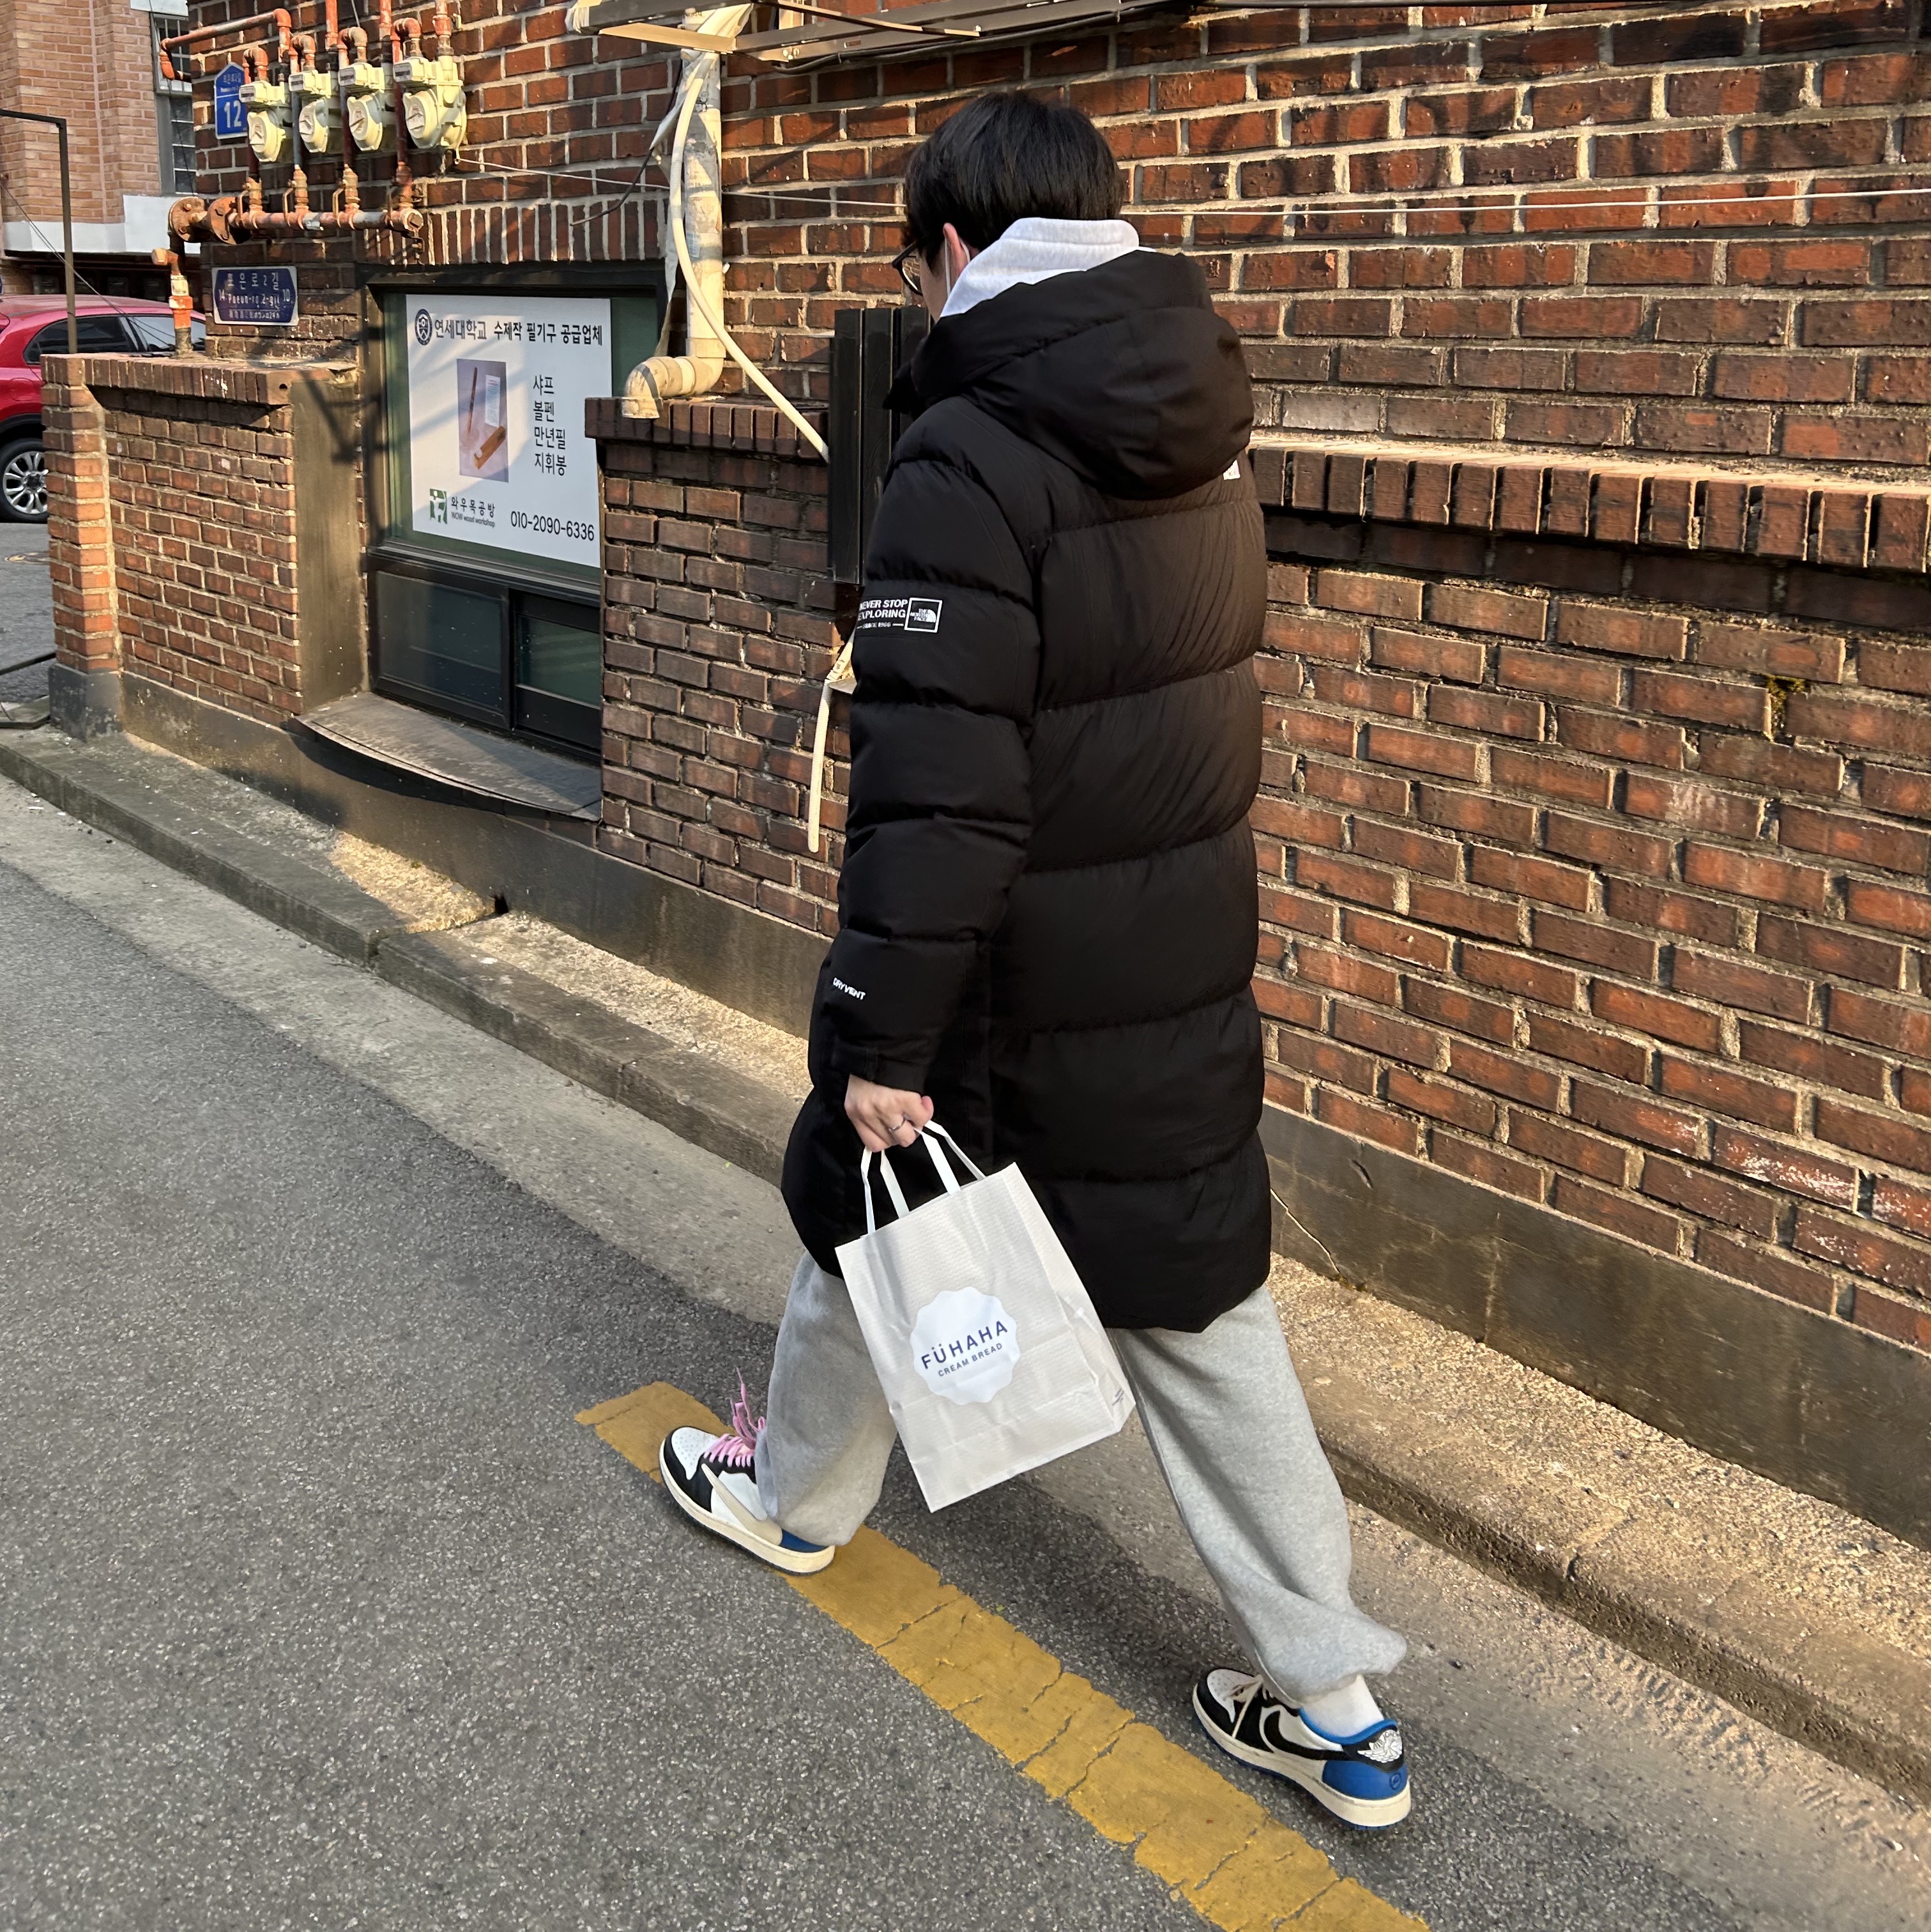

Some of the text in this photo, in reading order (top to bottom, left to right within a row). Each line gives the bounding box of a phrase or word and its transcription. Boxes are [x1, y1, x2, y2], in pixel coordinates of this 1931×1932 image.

[224, 100, 242, 128] 12
[282, 288, 290, 302] 10
[434, 319, 602, 346] 연세대학교 수제작 필기구 공급업체
[533, 374, 554, 395] 샤프
[533, 401, 554, 422] 볼펜
[534, 427, 566, 450] 만년필
[535, 452, 567, 476] 지휘봉
[451, 496, 495, 518] 와우목공방
[510, 510, 595, 542] 010-2090-6336
[883, 599, 908, 608] STOP
[921, 1320, 1008, 1369] FÜHAHA
[938, 1342, 1003, 1377] CREAM BREAD
